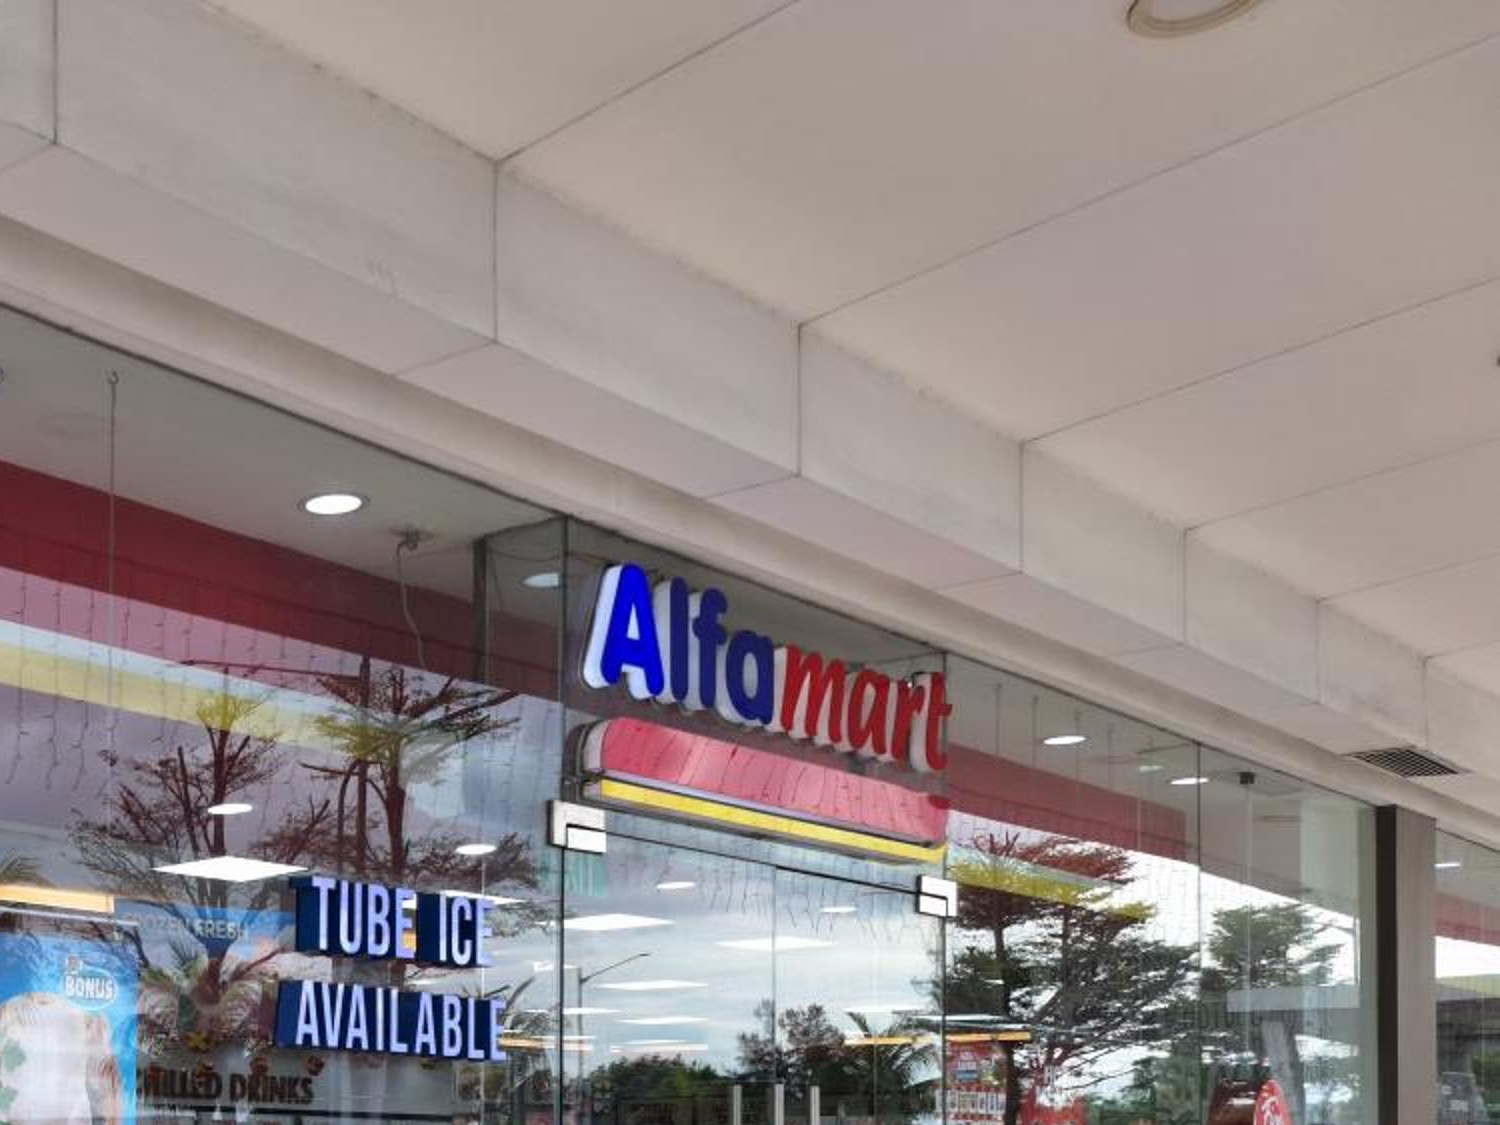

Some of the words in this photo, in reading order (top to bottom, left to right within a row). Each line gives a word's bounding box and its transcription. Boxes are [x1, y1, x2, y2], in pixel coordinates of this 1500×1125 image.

[584, 561, 952, 772] Alfamart
[312, 876, 417, 959] TUBE
[439, 896, 493, 968] ICE
[65, 975, 114, 1000] BONUS
[296, 979, 506, 1060] AVAILABLE
[136, 1065, 223, 1100] HILLED
[229, 1072, 314, 1105] DRINKS
